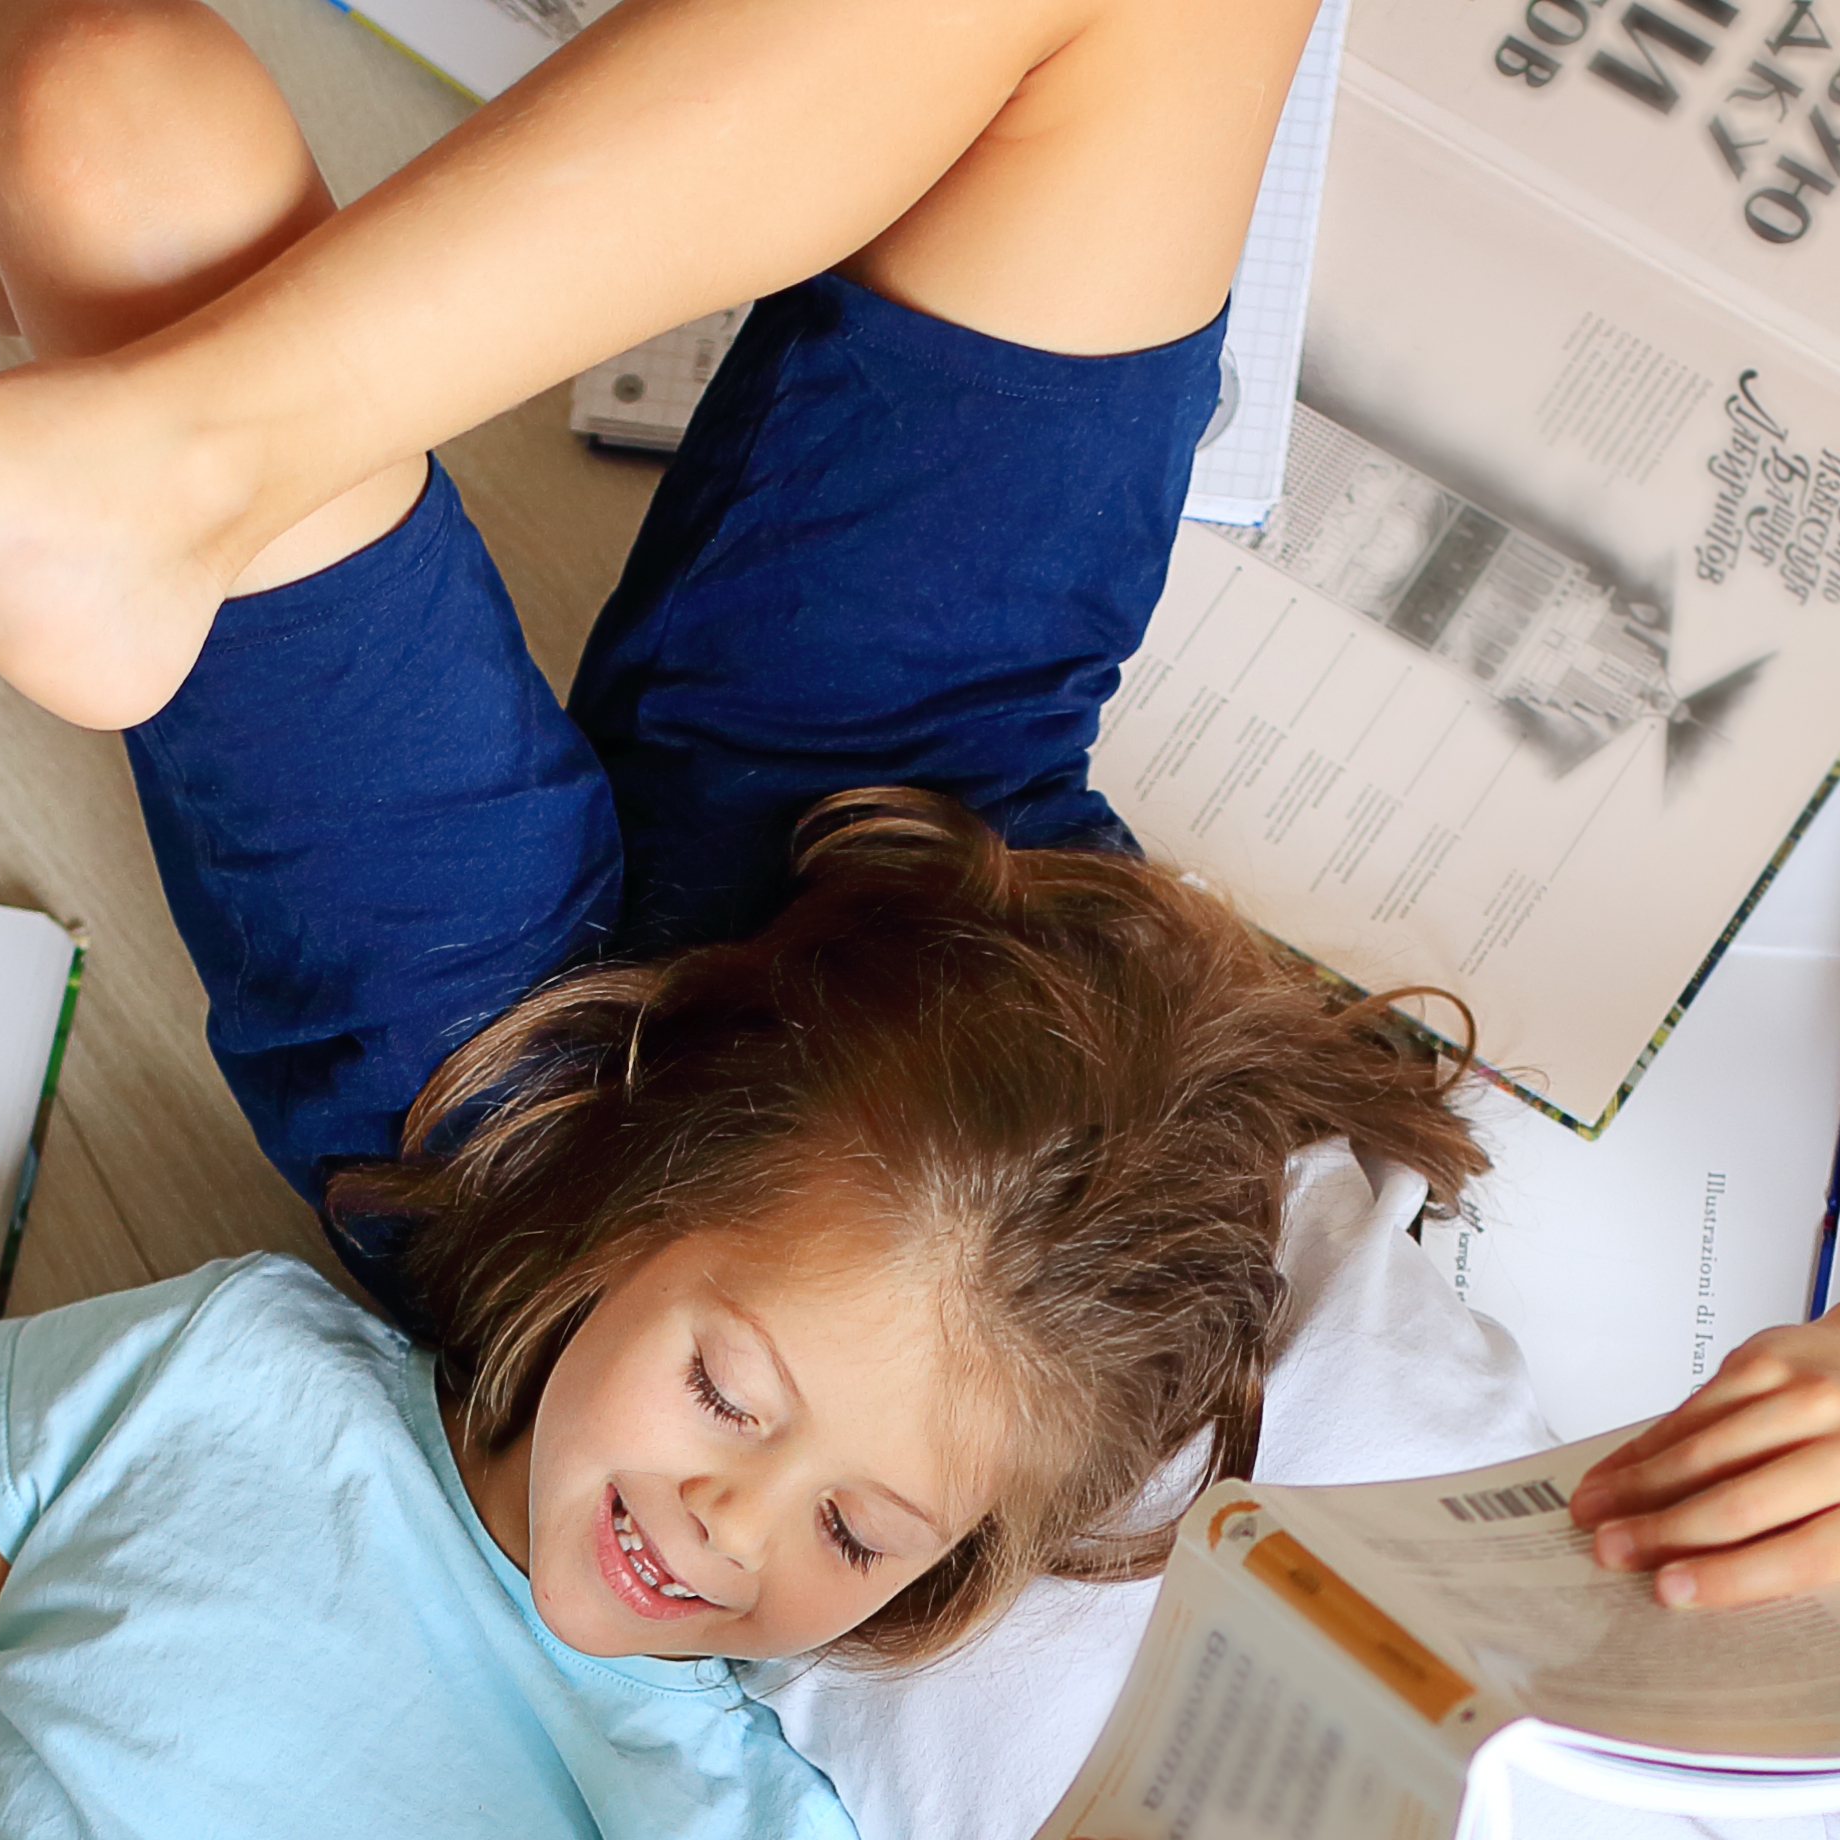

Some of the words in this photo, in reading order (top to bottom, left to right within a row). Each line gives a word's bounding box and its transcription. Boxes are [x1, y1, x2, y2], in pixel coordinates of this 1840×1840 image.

[1698, 1171, 1727, 1297] Illustrazioni
[1696, 1305, 1715, 1325] di
[1691, 1332, 1714, 1375] Ivan
